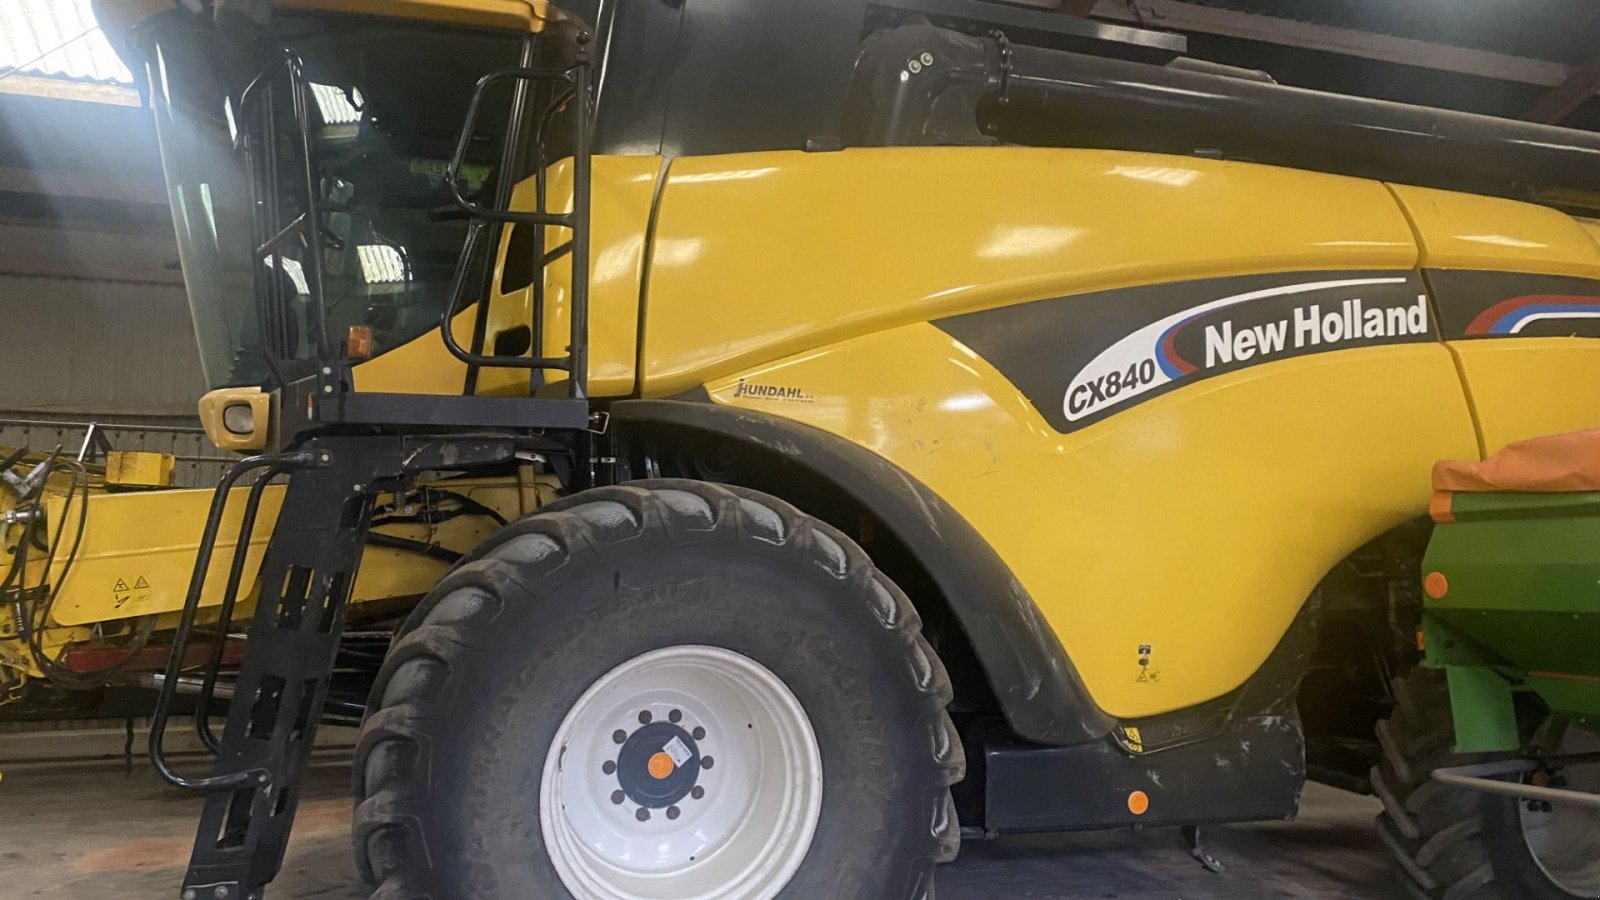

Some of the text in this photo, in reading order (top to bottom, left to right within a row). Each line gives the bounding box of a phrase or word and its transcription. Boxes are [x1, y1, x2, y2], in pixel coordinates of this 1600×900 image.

[1204, 294, 1428, 369] New Holland
[1068, 357, 1156, 415] CX840
